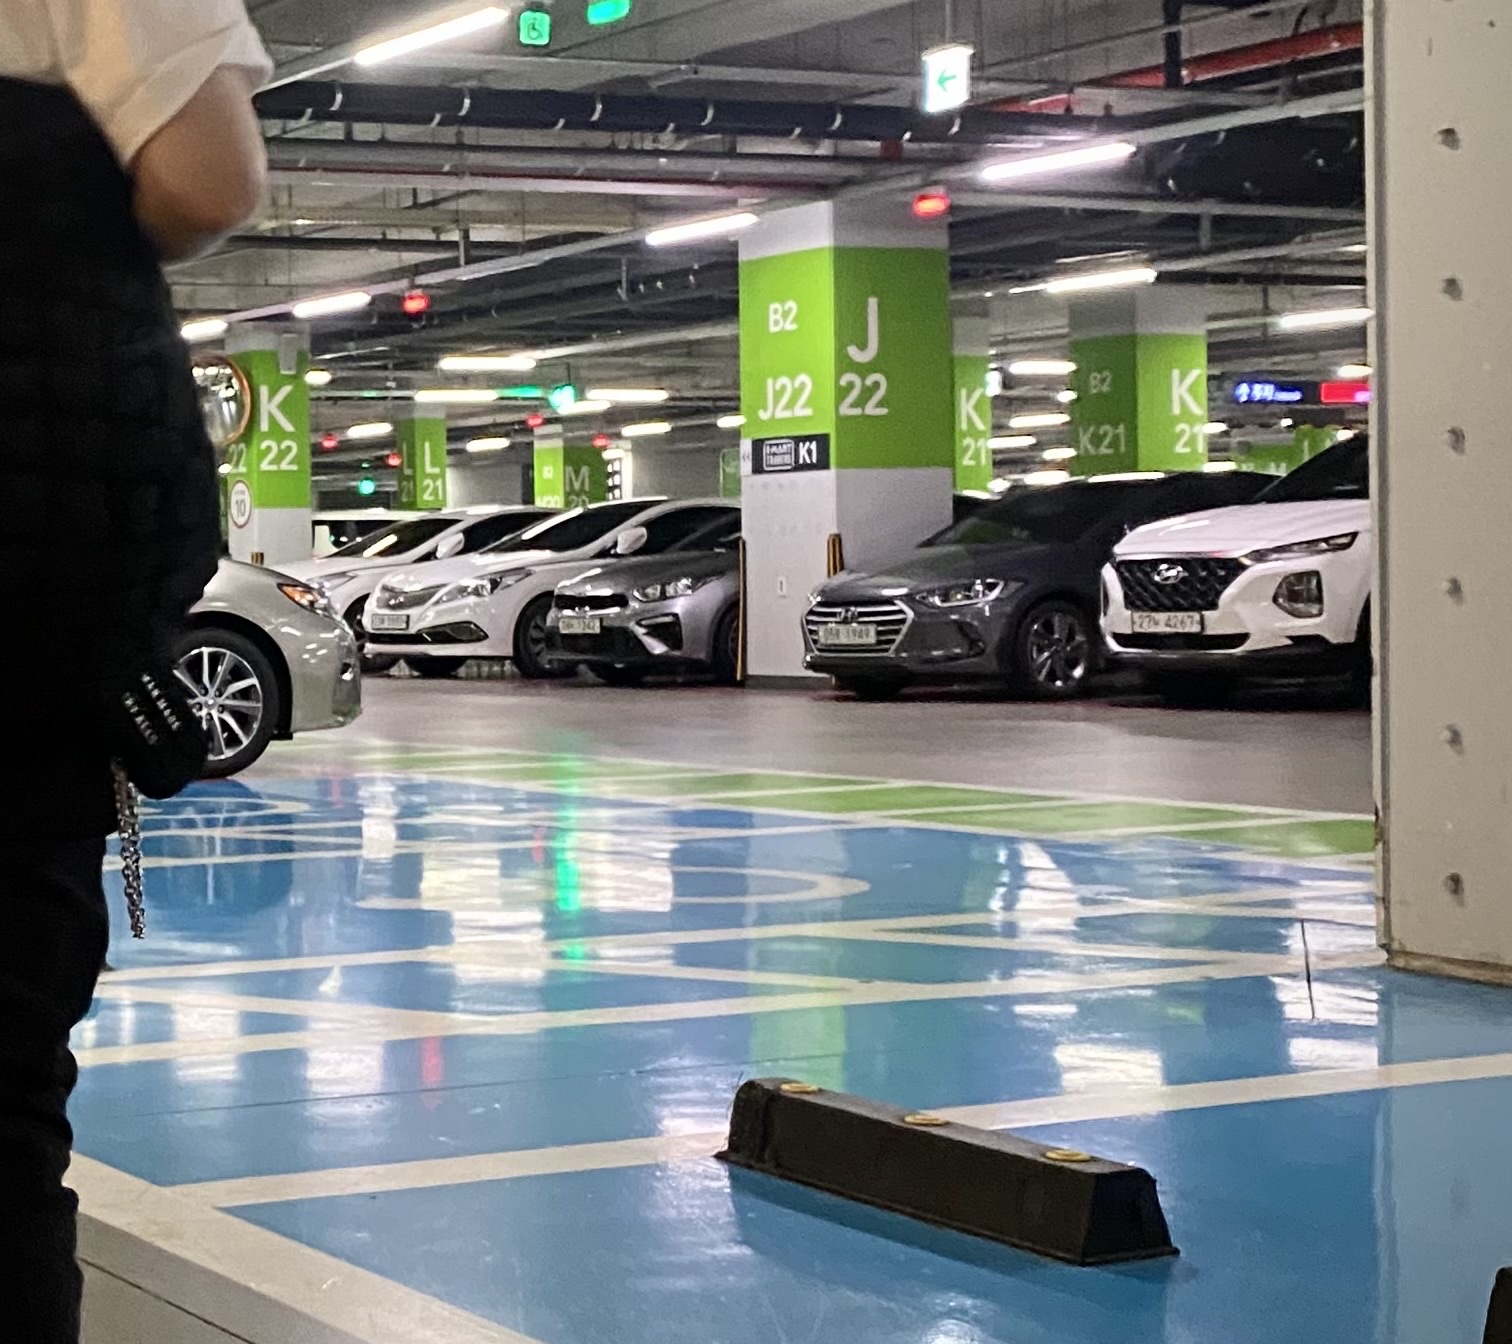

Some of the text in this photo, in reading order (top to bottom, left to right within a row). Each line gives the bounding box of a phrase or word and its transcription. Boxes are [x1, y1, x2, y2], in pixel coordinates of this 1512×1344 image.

[769, 300, 798, 333] B2
[846, 297, 879, 364] J
[757, 373, 813, 421] J22
[839, 372, 889, 416] 22
[1089, 371, 1112, 394] B2
[1170, 368, 1205, 416] K
[259, 384, 296, 433] K
[959, 386, 987, 432] K
[798, 440, 818, 465] K1
[962, 436, 987, 467] 21
[1077, 422, 1126, 456] K21
[1174, 422, 1205, 455] 21
[259, 439, 299, 472] 22
[424, 441, 441, 475] L
[422, 478, 444, 502] 21
[565, 465, 590, 492] M
